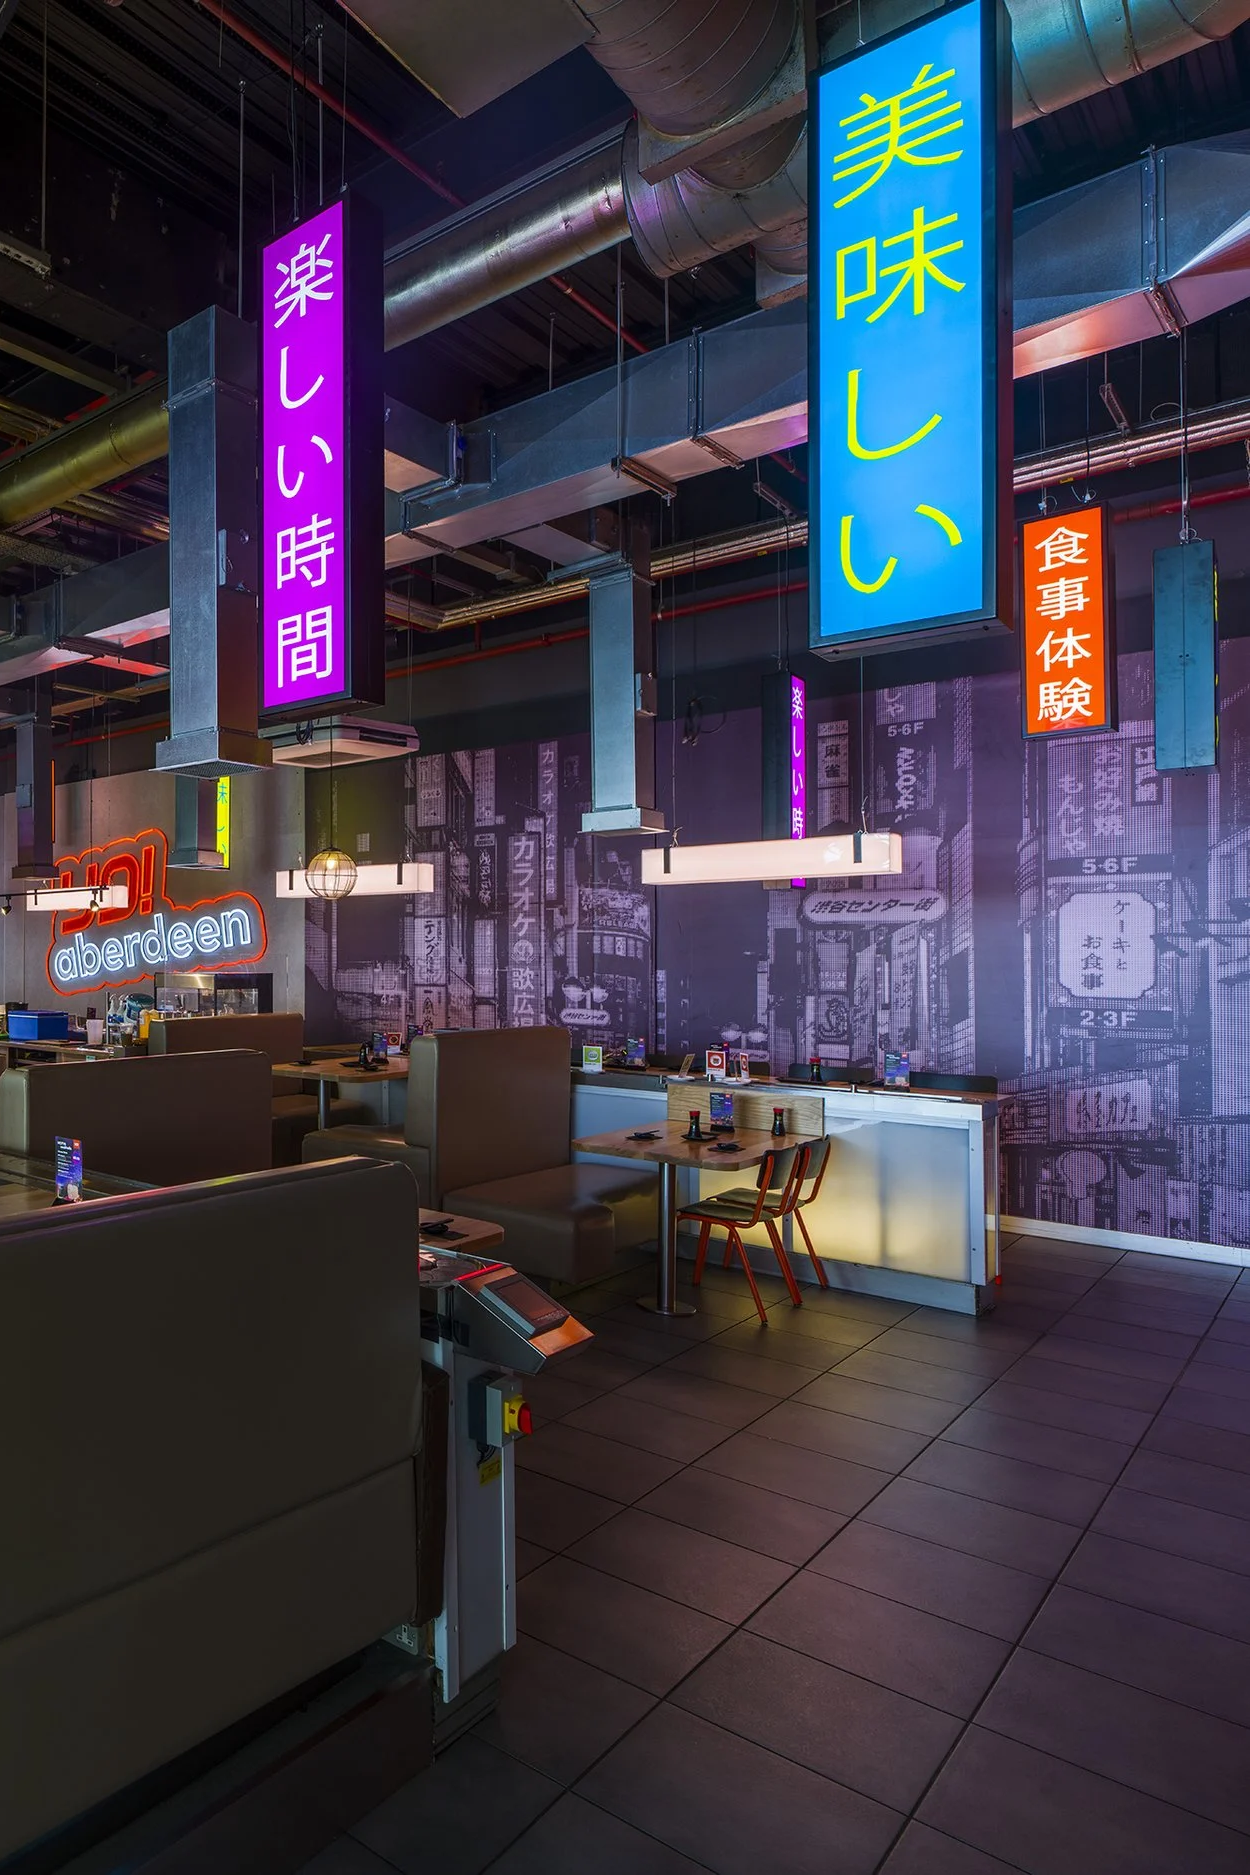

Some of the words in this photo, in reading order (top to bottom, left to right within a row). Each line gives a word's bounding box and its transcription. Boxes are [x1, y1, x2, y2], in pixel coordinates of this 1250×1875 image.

[832, 63, 966, 594] 美味しい
[274, 233, 334, 688] 楽しい時間
[1035, 525, 1092, 721] 食事体験
[791, 686, 805, 877] 楽しい時
[825, 744, 841, 778] 麻雀
[1094, 745, 1125, 836] お好み焼
[54, 908, 251, 981] aberdeen
[811, 897, 940, 913] 渋谷センター街
[1113, 899, 1130, 970] ケーキと
[1081, 935, 1104, 989] お食事
